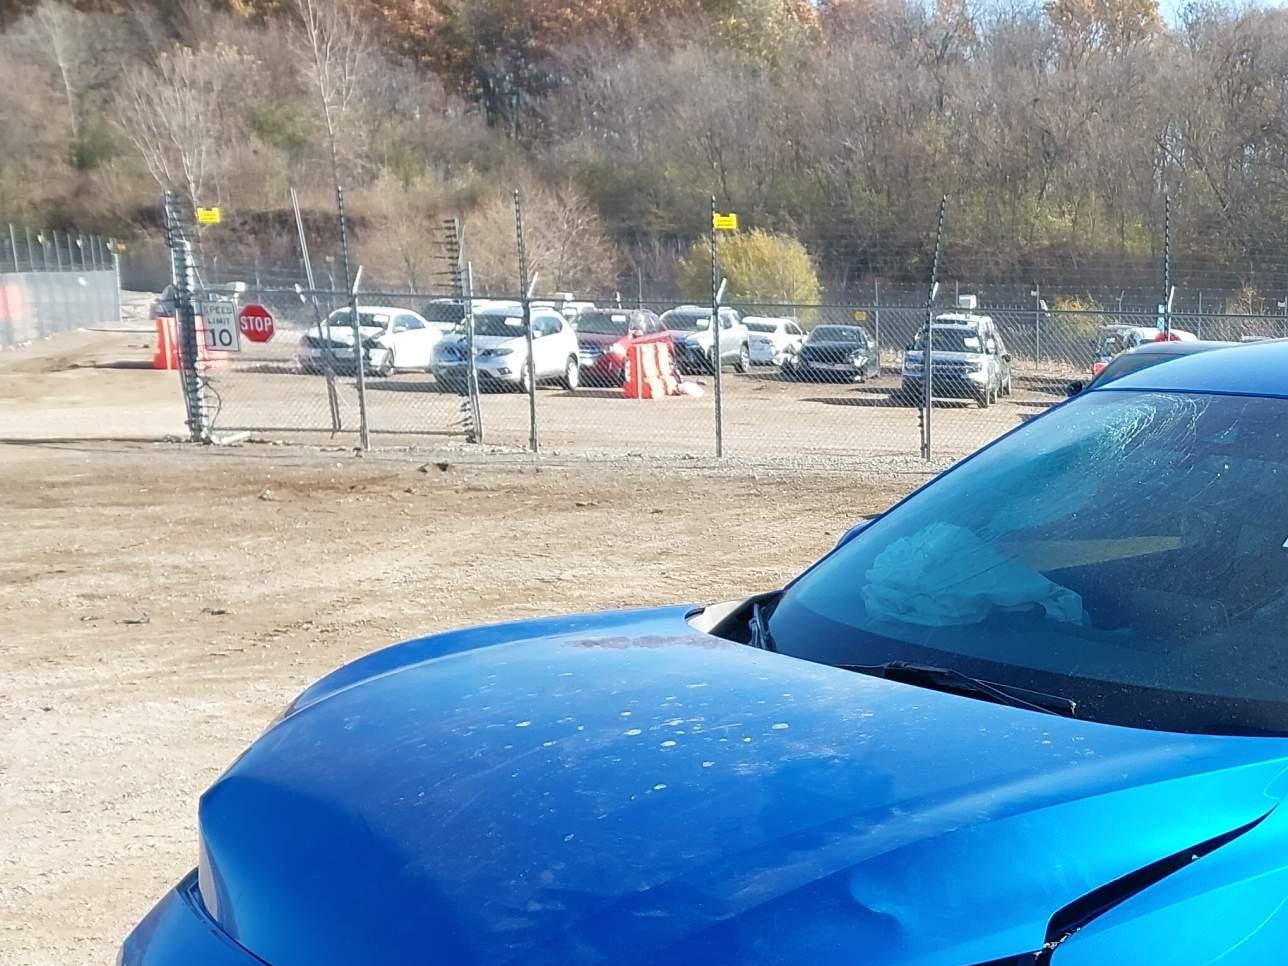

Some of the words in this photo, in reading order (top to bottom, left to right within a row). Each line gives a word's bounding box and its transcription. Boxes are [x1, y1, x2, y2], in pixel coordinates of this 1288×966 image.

[207, 317, 230, 325] LIMIT
[240, 315, 272, 332] STOP
[209, 328, 233, 347] 10
